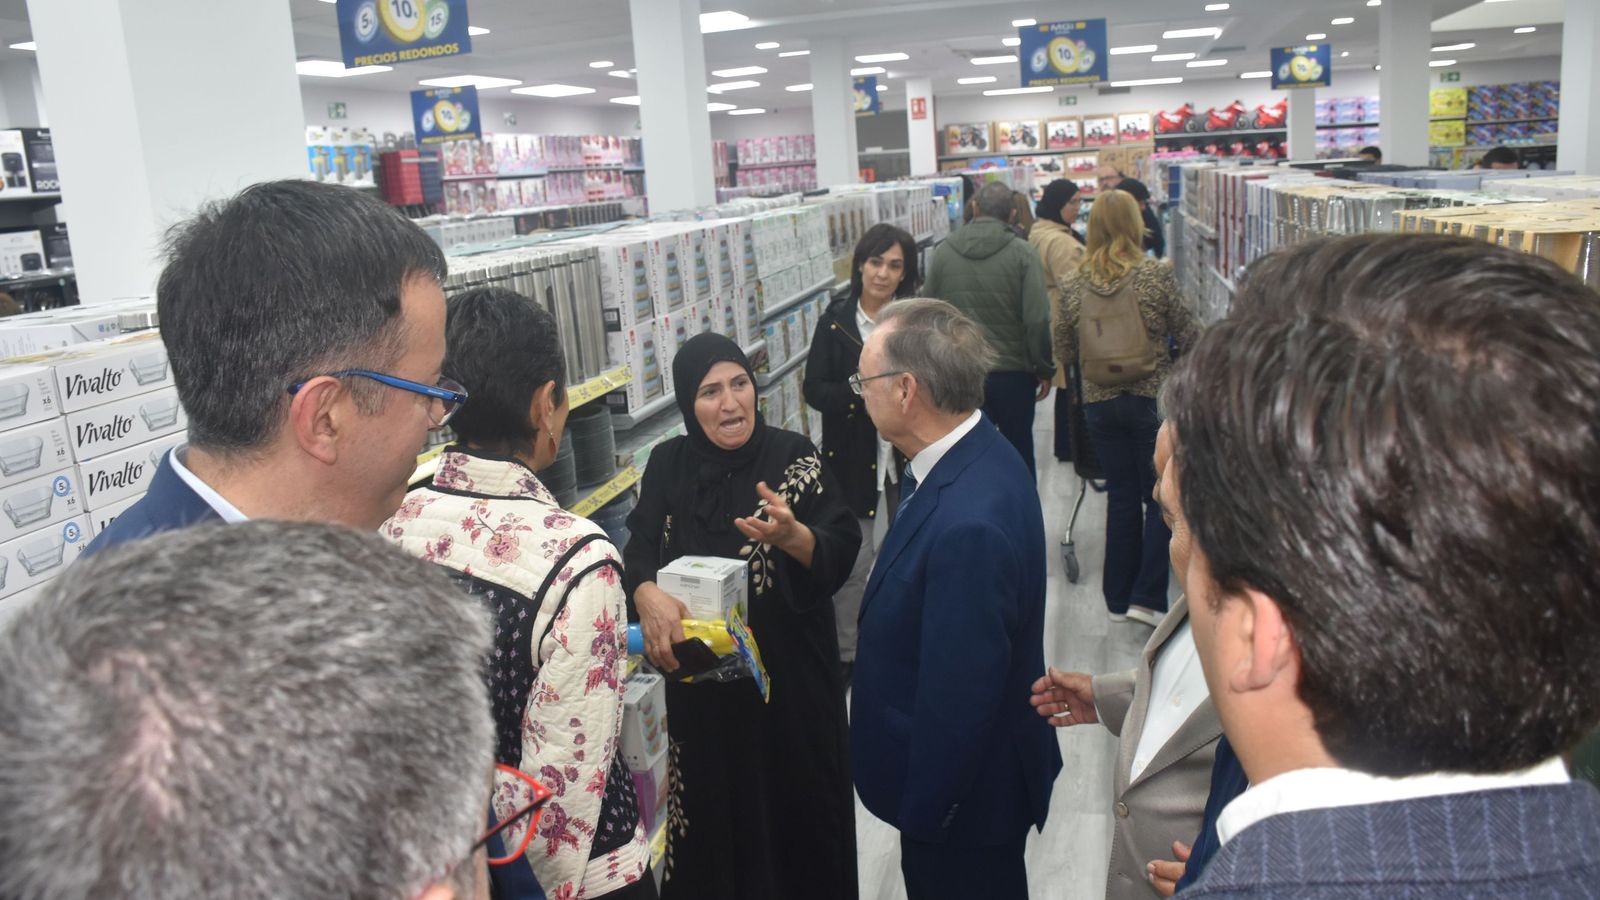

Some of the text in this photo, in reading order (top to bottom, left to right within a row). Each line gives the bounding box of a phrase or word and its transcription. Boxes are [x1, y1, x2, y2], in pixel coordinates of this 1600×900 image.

[354, 43, 460, 66] PRECIOS REDONDOS
[66, 368, 121, 399] Vivalto
[76, 414, 133, 449] Vivalto
[88, 462, 144, 496] Vivalto
